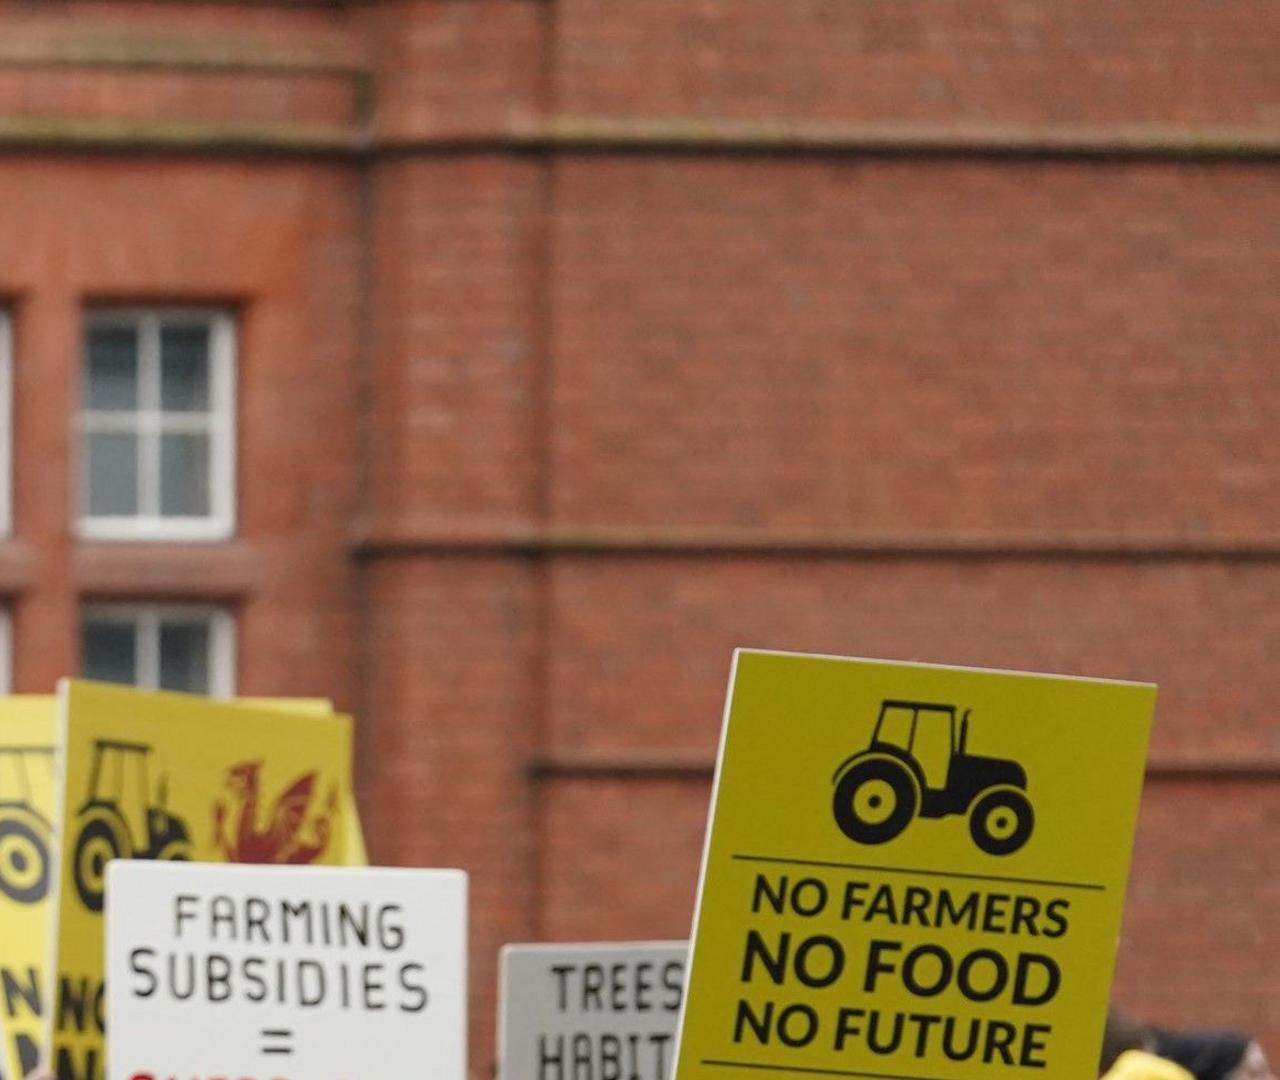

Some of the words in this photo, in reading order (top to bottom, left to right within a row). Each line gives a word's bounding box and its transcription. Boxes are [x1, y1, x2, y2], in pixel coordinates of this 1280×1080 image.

[174, 896, 406, 952] FARMING
[751, 873, 828, 918] NO
[840, 881, 1071, 939] FARMERS
[130, 948, 429, 1013] SUBSIDIES
[551, 961, 683, 1013] TREES
[741, 929, 845, 989] NO
[863, 939, 1062, 1007] FOOD
[733, 999, 819, 1048] NO
[834, 1006, 1052, 1068] FUTURE
